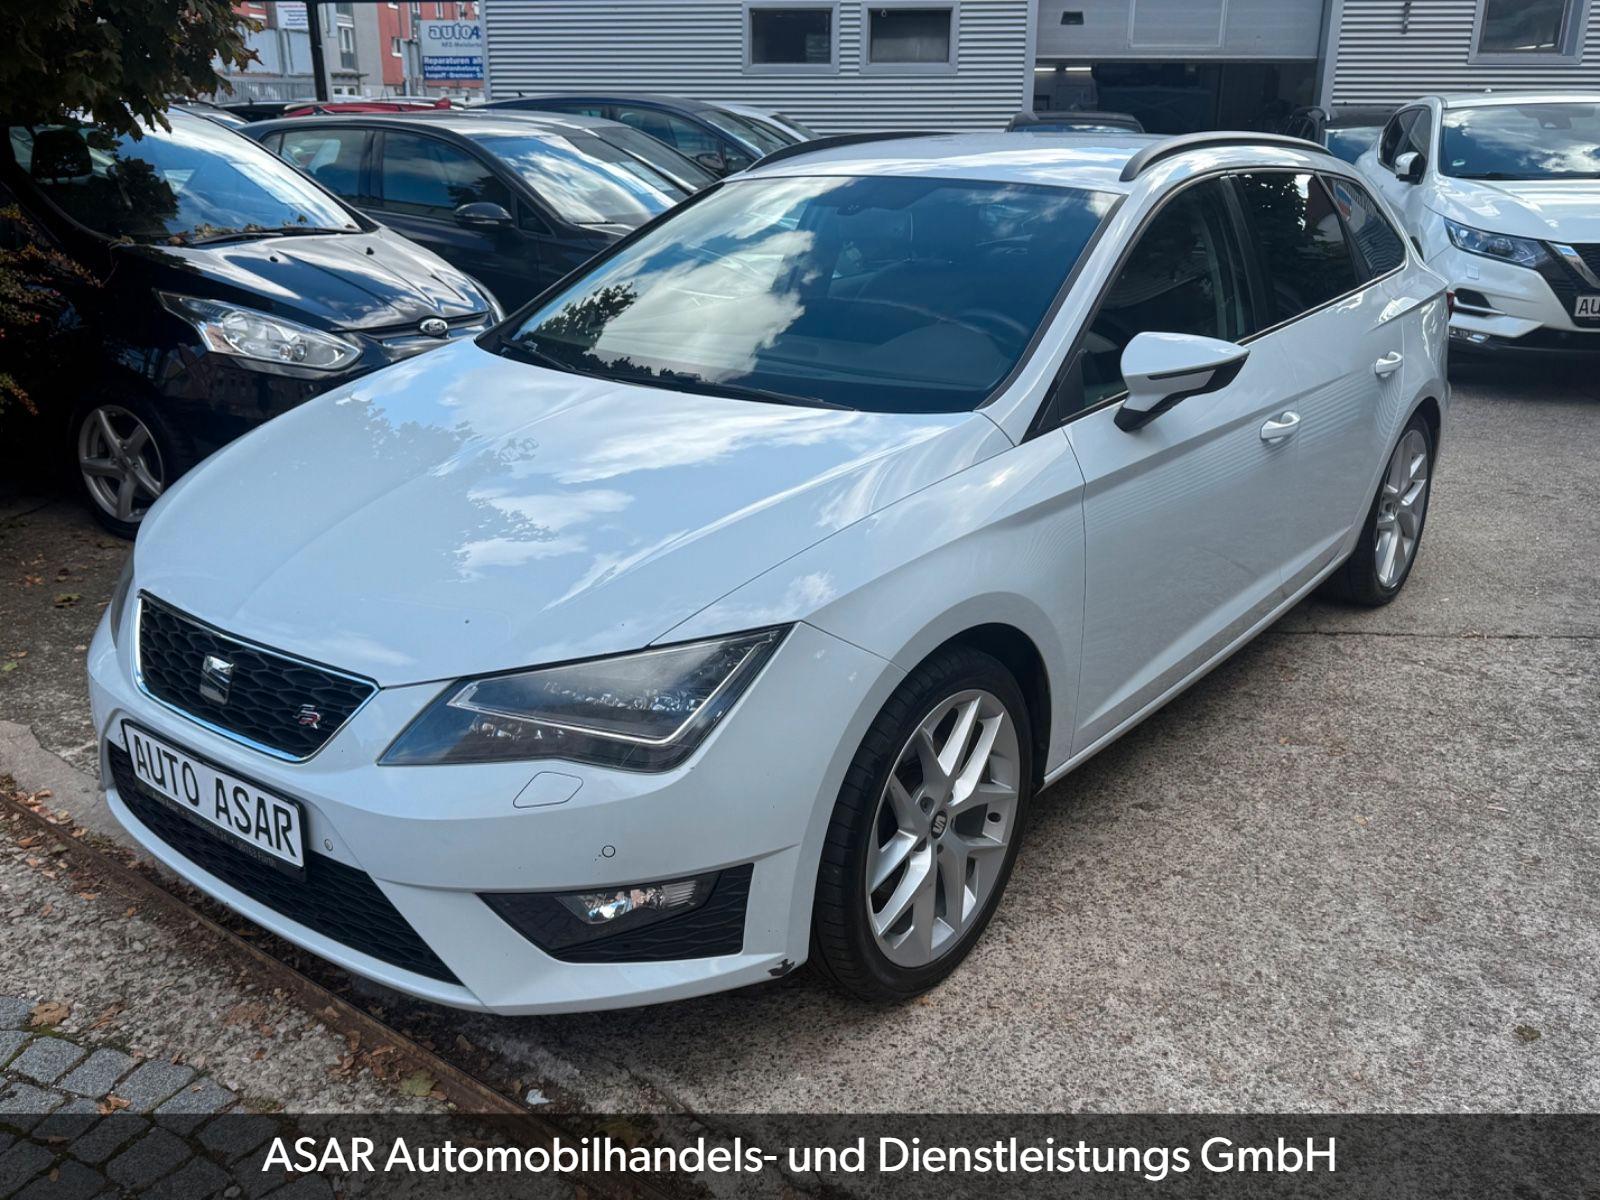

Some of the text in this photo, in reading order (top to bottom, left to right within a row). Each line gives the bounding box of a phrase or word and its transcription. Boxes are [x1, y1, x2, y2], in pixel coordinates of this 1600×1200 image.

[429, 23, 482, 40] autoA
[424, 56, 470, 65] Reparaturen
[133, 734, 200, 807] AUTO
[214, 776, 298, 858] ASAR
